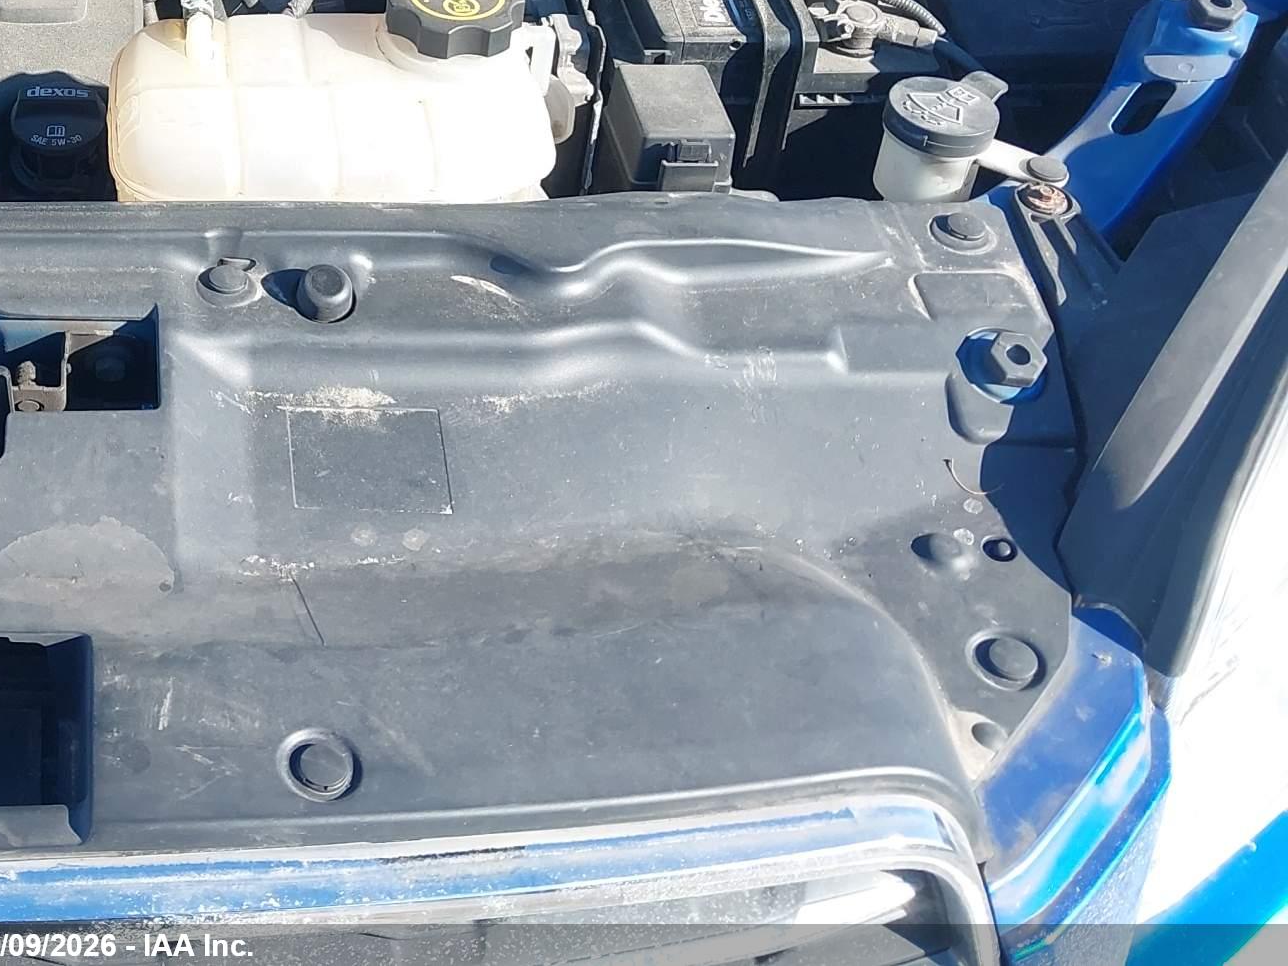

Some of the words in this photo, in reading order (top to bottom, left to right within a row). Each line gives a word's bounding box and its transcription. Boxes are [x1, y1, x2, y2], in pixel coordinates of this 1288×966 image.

[26, 86, 89, 98] dexos
[30, 134, 49, 146] SAE
[51, 134, 82, 146] 5W-30
